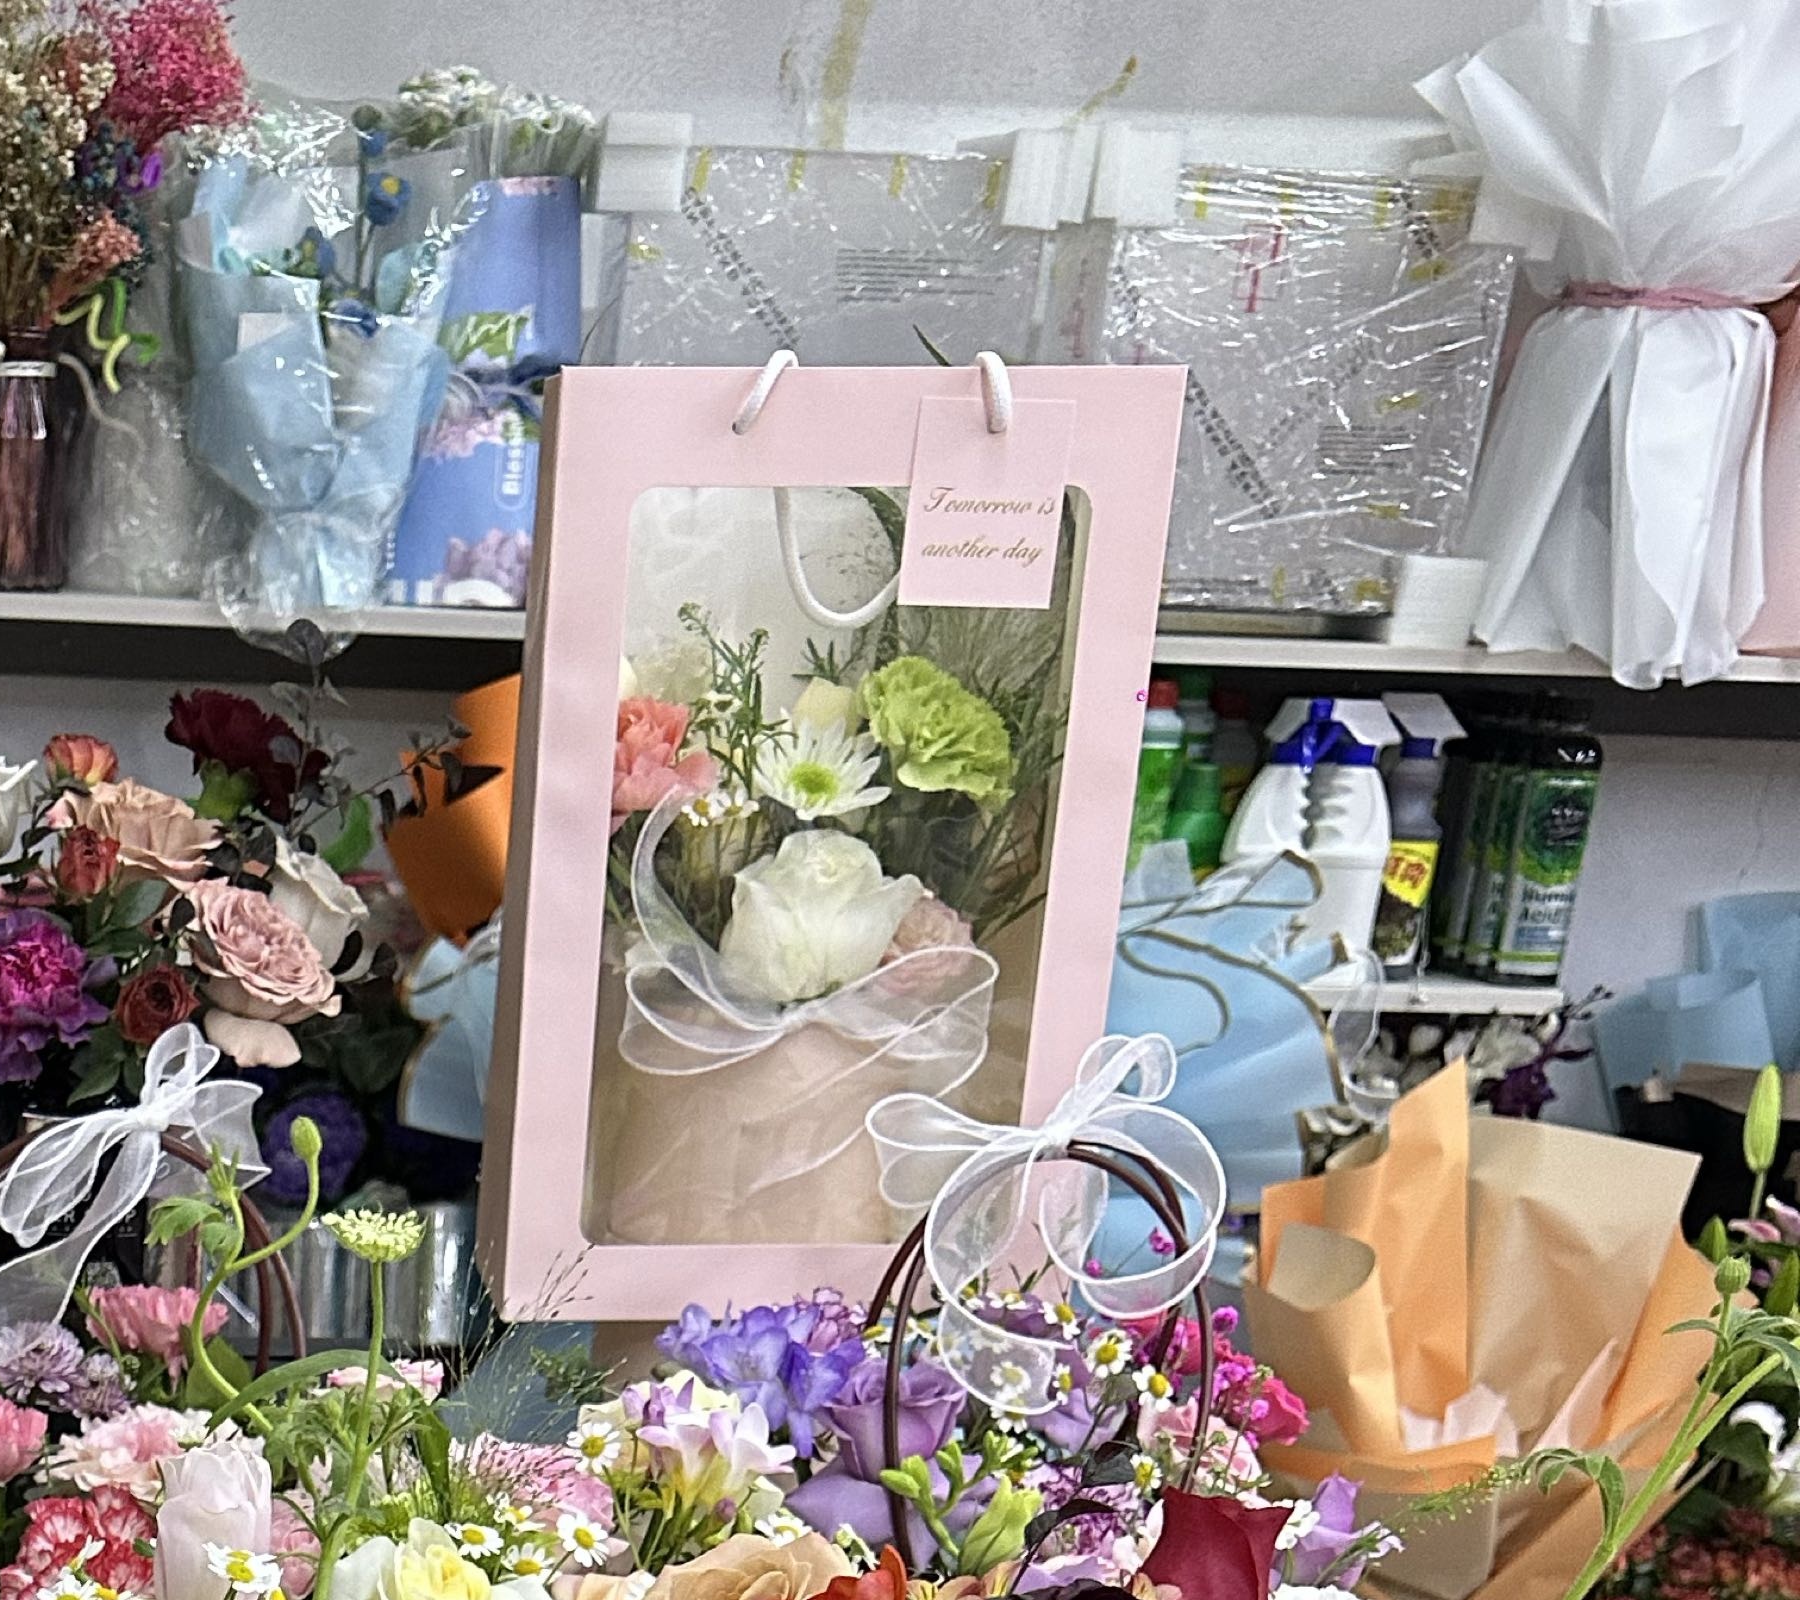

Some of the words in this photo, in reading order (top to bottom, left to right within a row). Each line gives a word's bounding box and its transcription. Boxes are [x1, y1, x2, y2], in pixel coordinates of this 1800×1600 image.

[923, 486, 1032, 514] Tomorrow
[1037, 497, 1055, 515] is
[921, 534, 999, 558] another
[1002, 537, 1042, 568] day
